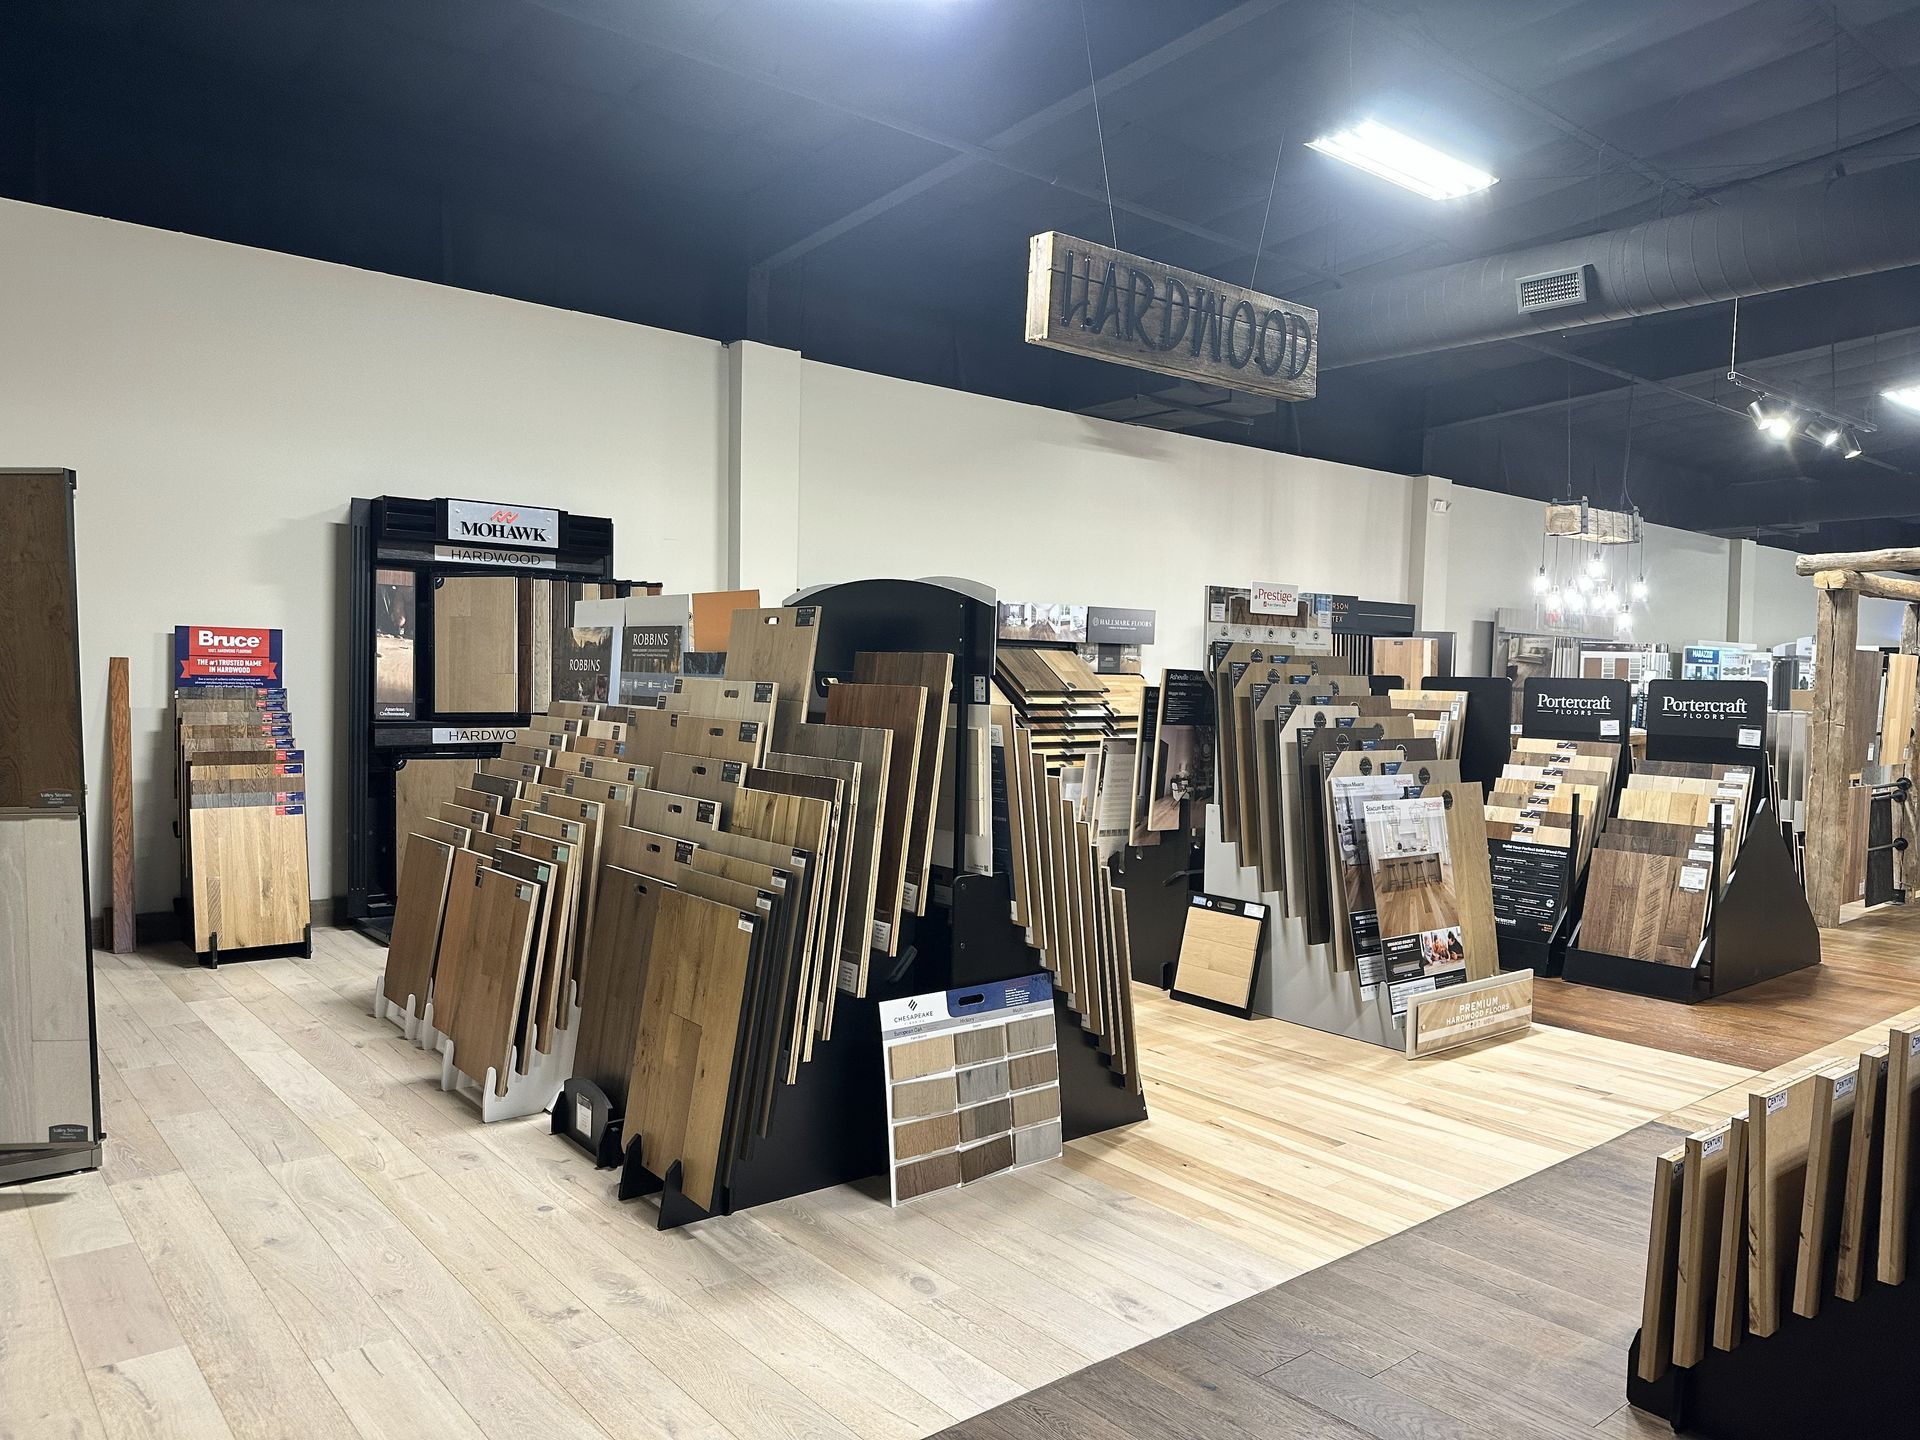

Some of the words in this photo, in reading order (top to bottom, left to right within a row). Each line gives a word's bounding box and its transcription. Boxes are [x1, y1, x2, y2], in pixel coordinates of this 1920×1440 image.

[1060, 250, 1311, 380] HARDWOOD
[461, 520, 547, 542] MOHAWK
[451, 549, 541, 566] HARDWOOD
[1258, 588, 1292, 604] Prestige
[1332, 602, 1348, 610] RSON
[1100, 618, 1130, 626] HALLMARK
[198, 630, 260, 648] Bruce
[632, 633, 669, 646] ROBBINS
[197, 658, 209, 666] THE
[219, 659, 244, 667] TRUSTED
[216, 666, 251, 674] HARDWOOD
[569, 658, 601, 672] ROBBINS
[1537, 693, 1611, 710] Portercraft
[1662, 696, 1747, 713] Portercraft
[1683, 712, 1725, 720] FLOORS
[449, 729, 517, 741] HARDWO
[1459, 996, 1499, 1013] PREMIUM
[893, 1010, 934, 1023] CHESAPEAKE
[1446, 1010, 1484, 1026] HARDWOOD
[1485, 1003, 1510, 1016] FLOORS
[1835, 1076, 1854, 1093] CENTURY
[1767, 1092, 1786, 1108] CENTURY
[1703, 1135, 1723, 1152] CENTURY
